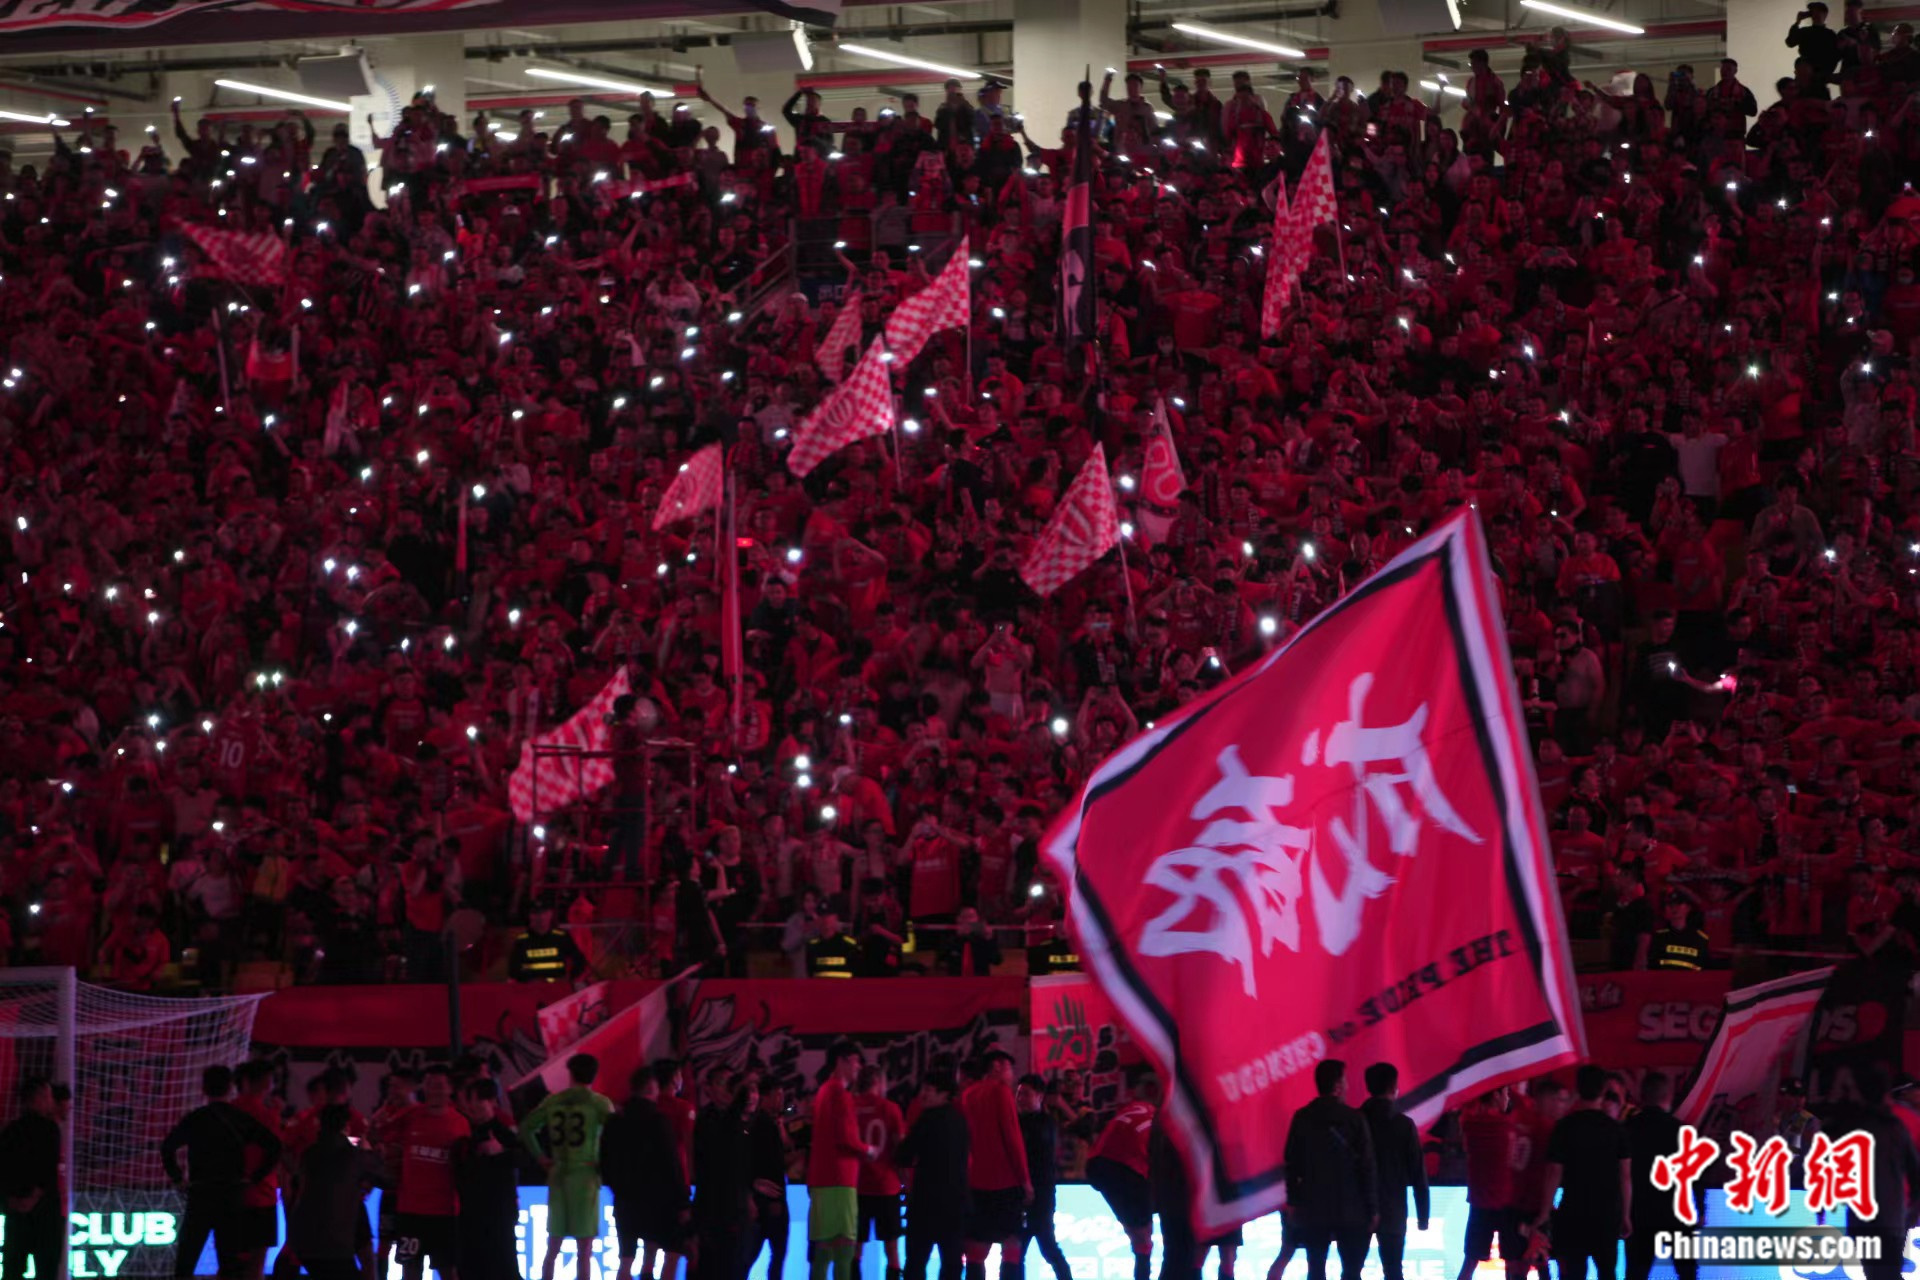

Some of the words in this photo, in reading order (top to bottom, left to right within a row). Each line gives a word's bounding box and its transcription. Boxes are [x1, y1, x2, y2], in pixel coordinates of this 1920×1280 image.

[219, 738, 245, 768] 10
[549, 1110, 586, 1147] 33
[68, 1211, 178, 1247] CLUB
[399, 1236, 421, 1256] 20
